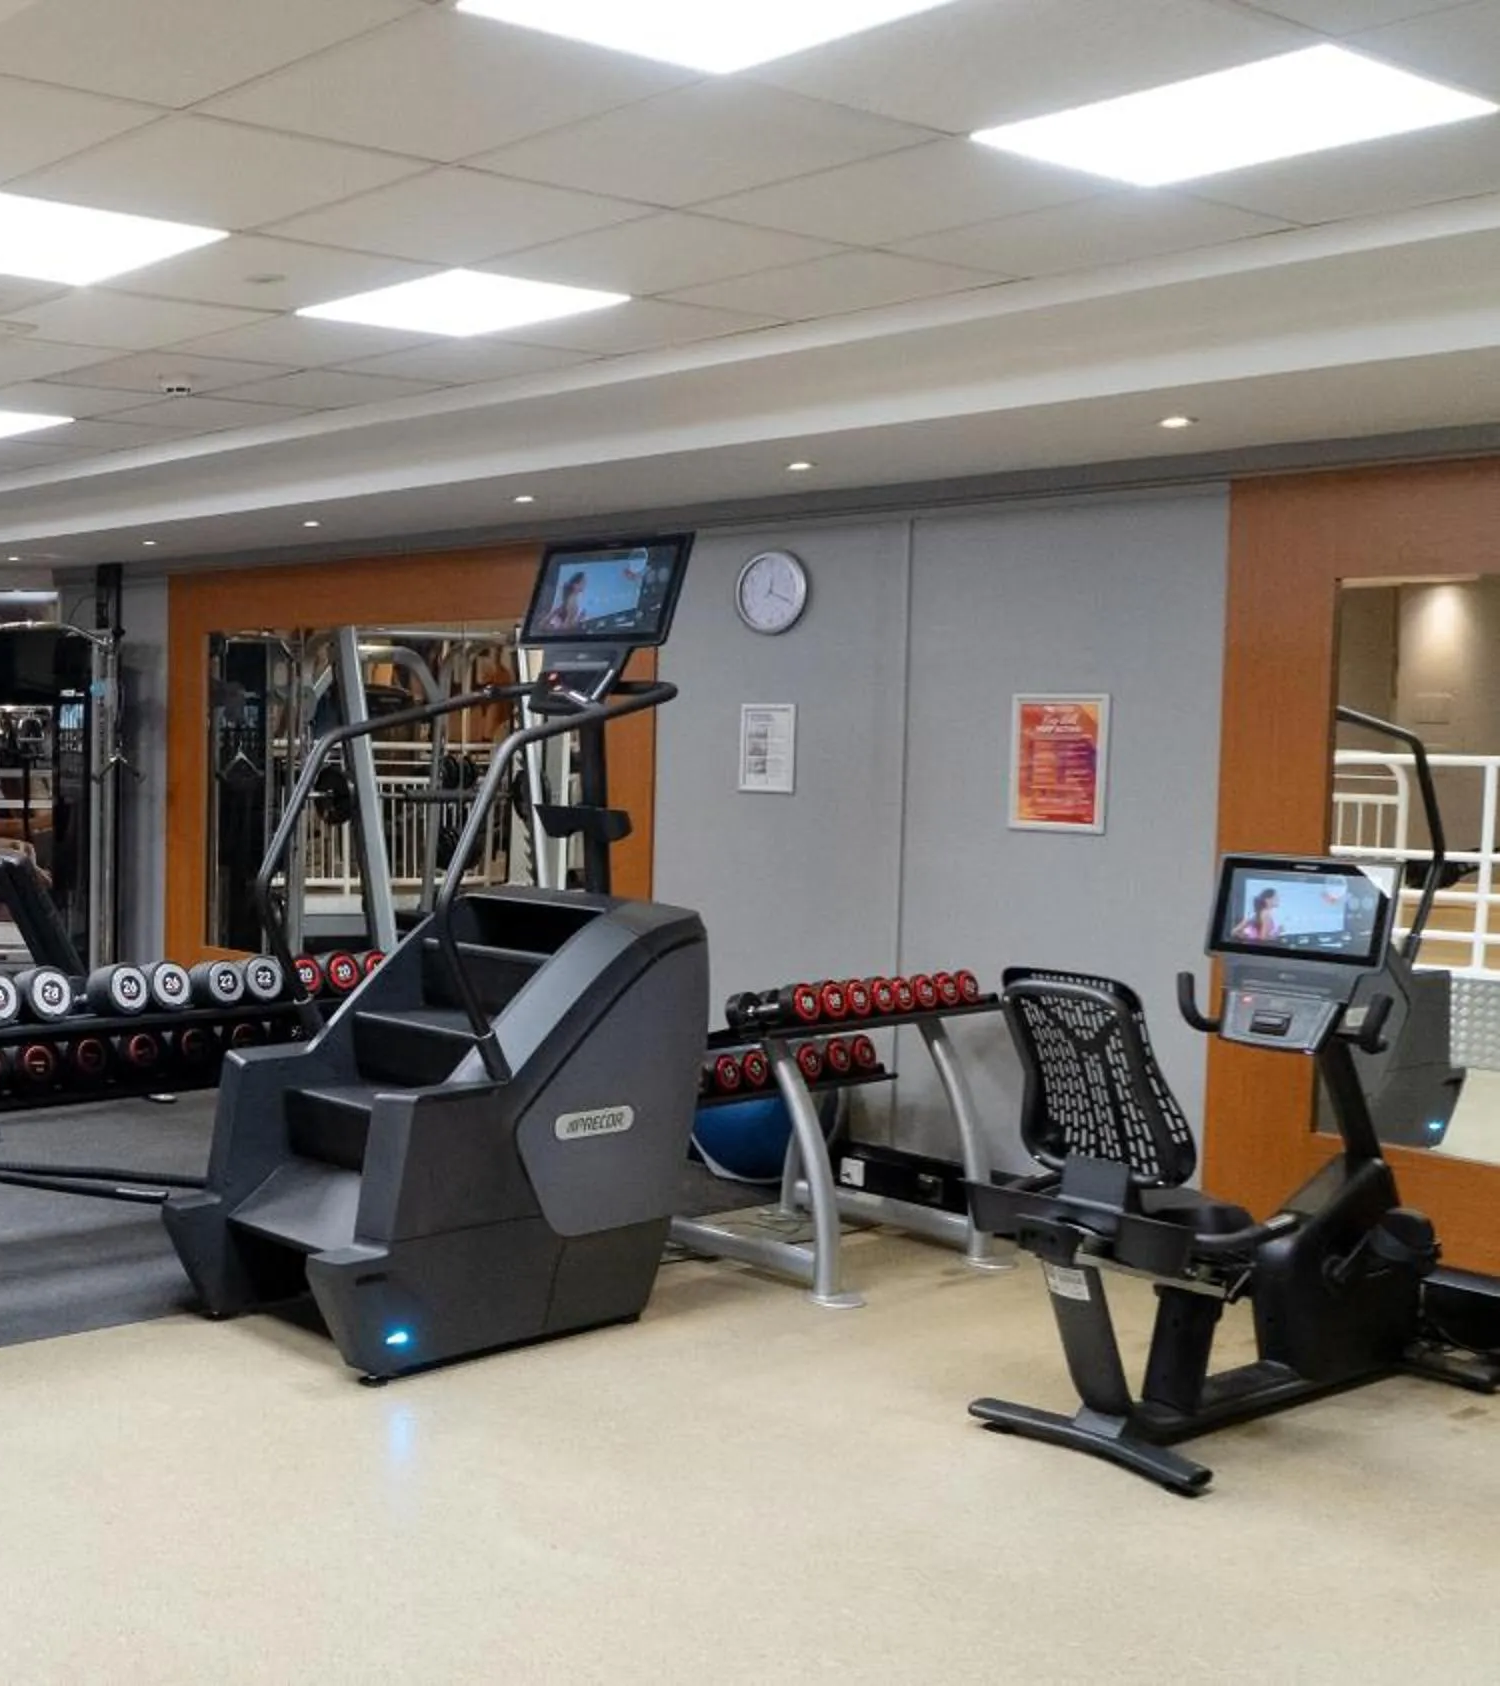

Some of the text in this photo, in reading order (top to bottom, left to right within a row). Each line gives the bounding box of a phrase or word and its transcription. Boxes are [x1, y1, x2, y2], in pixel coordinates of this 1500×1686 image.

[219, 975, 235, 988] 22
[257, 971, 271, 983] 22
[123, 981, 137, 994] 26
